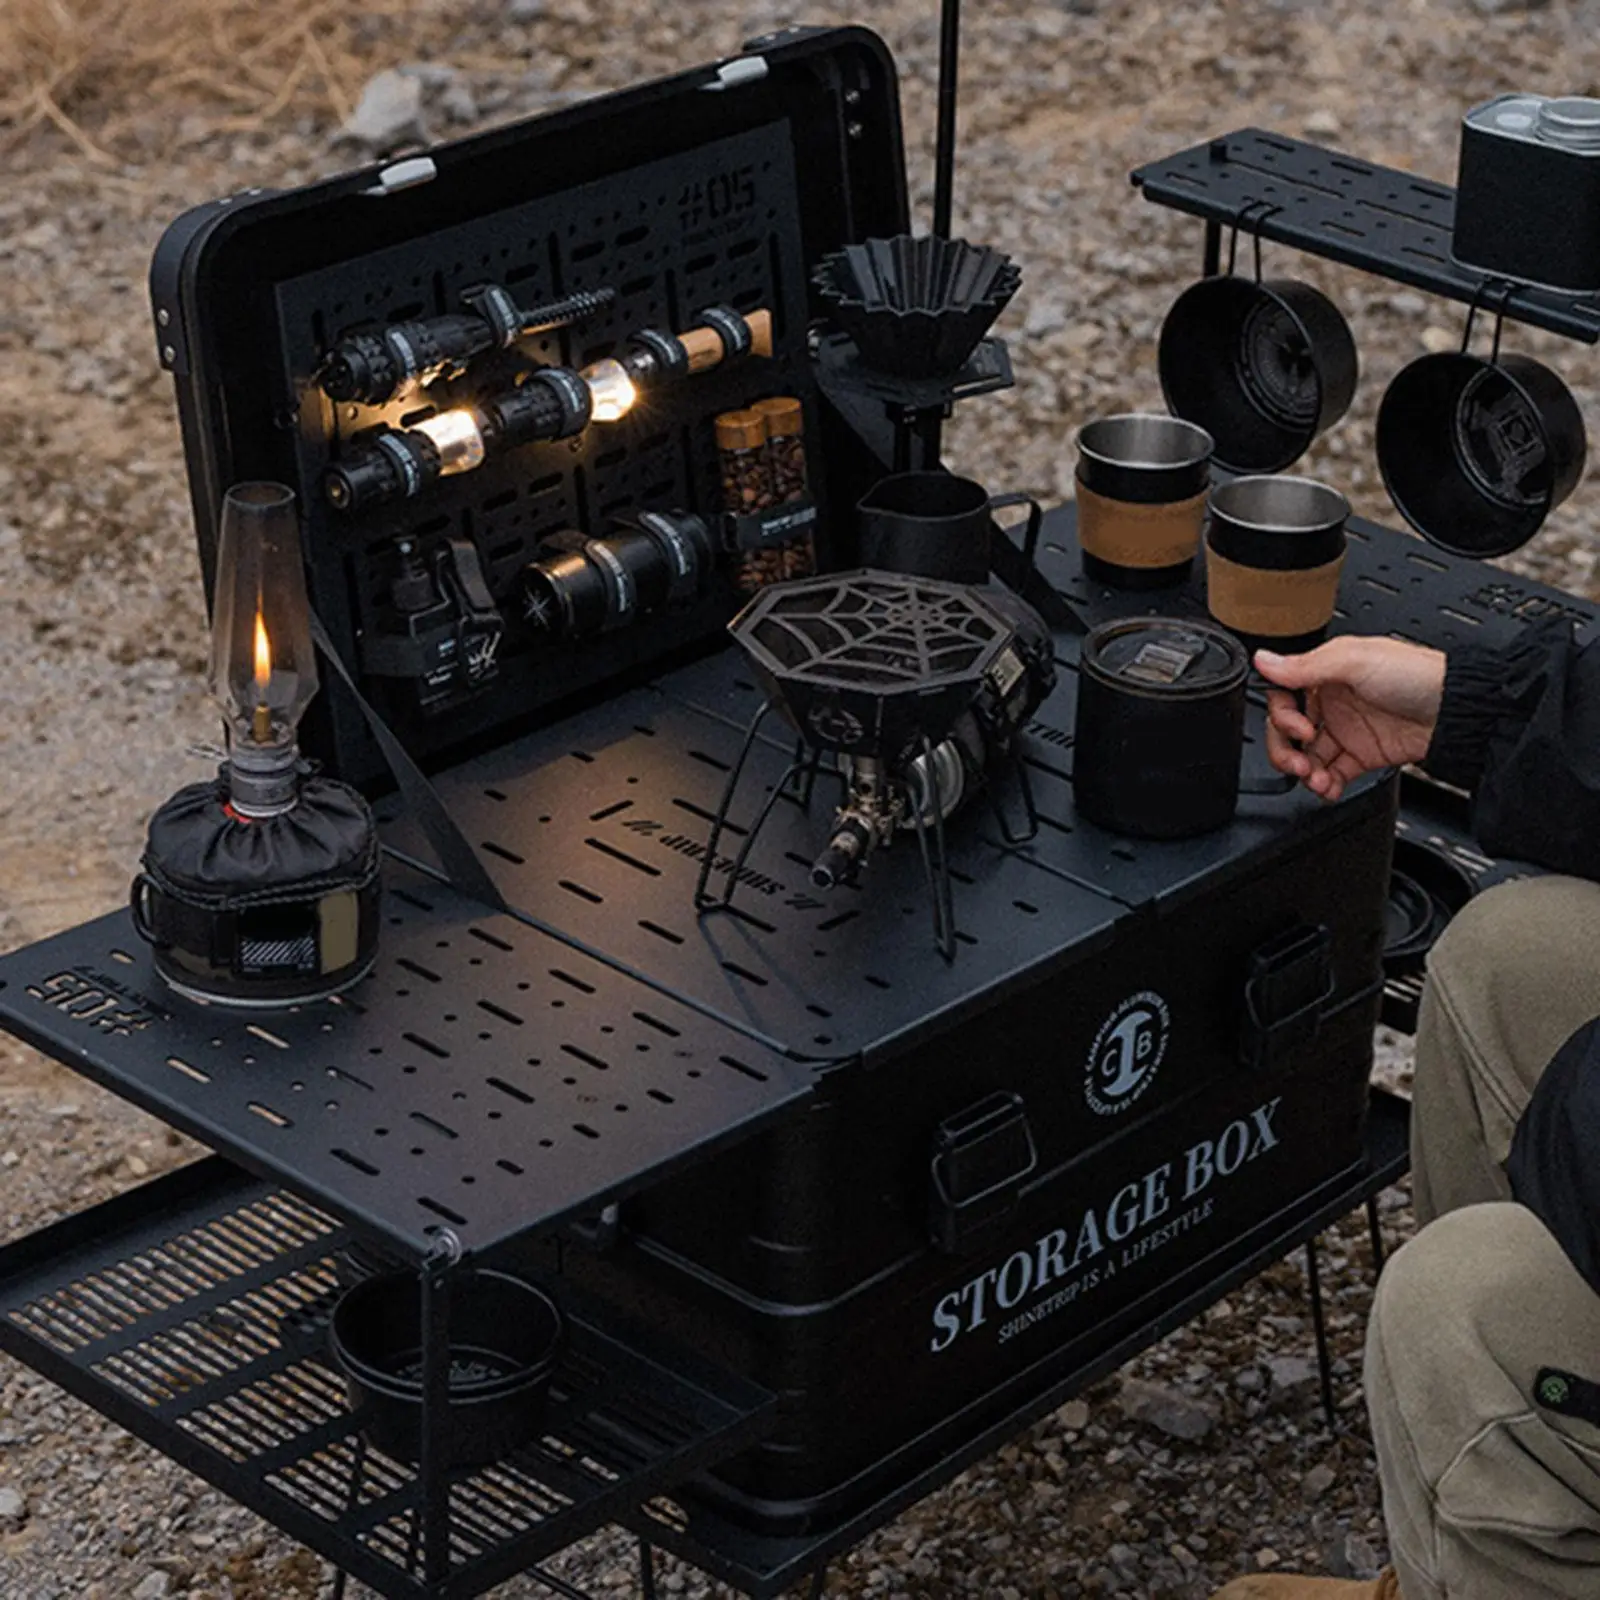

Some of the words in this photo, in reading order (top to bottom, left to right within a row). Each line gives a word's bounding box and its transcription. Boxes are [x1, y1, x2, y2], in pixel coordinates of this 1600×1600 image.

[930, 1161, 1171, 1353] STORAGE
[1181, 1096, 1283, 1200] BOX
[1081, 1267, 1102, 1294] IS
[1103, 1259, 1117, 1280] A
[1121, 1197, 1216, 1268] LIFESTYLE
